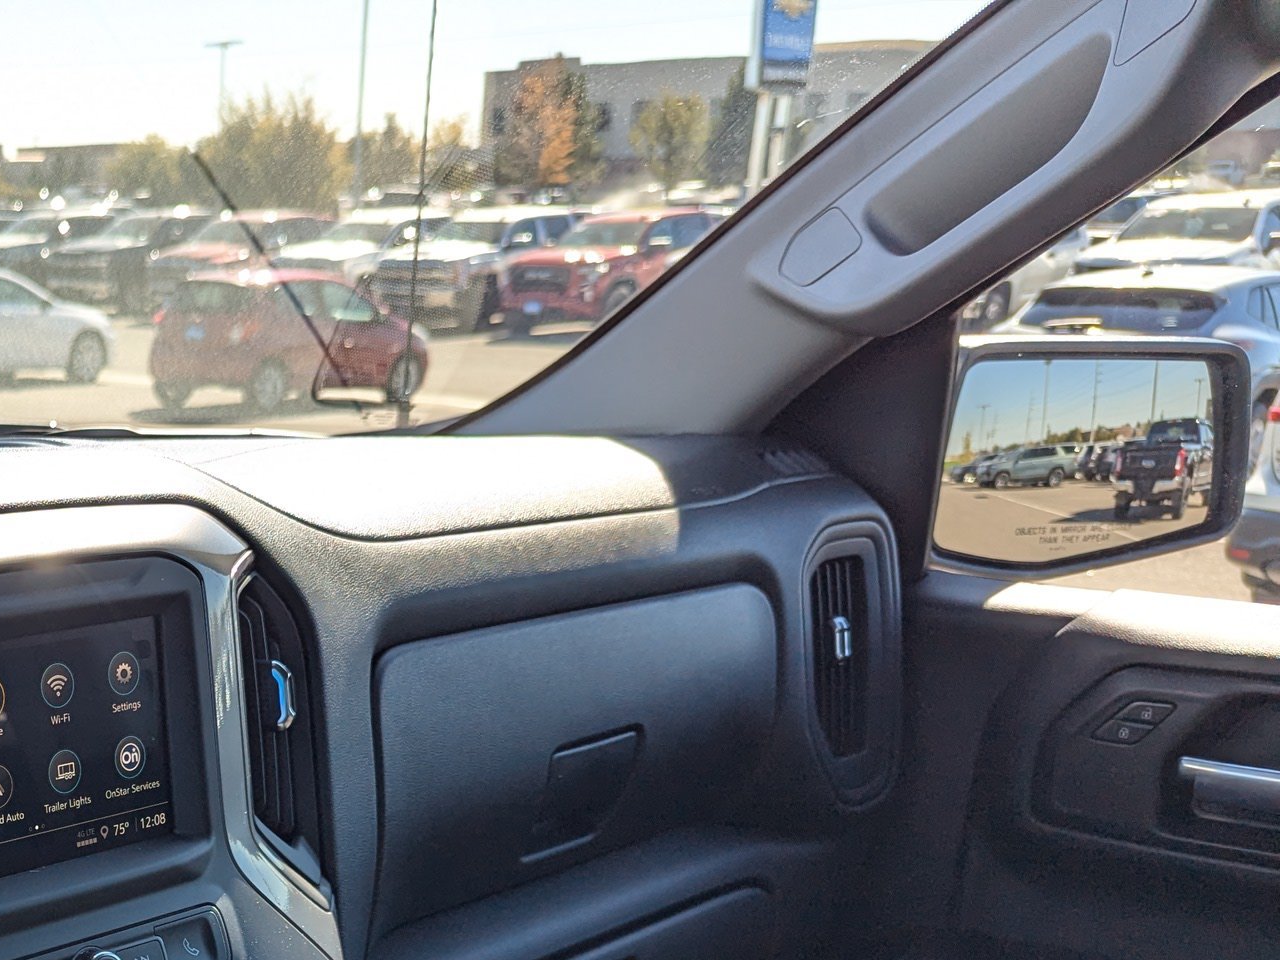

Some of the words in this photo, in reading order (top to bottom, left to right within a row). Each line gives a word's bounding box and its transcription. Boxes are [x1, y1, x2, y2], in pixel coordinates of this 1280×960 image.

[1015, 526, 1047, 536] OBJECTS
[1050, 526, 1057, 534] IN
[1061, 525, 1087, 533] MIRROR
[1039, 535, 1058, 544] THAN
[1062, 534, 1080, 543] THEY
[1083, 533, 1111, 543] APPEAR
[112, 699, 141, 714] Settings
[50, 713, 71, 725] Wi-Fi
[121, 747, 139, 765] On
[105, 787, 130, 801] OnStar
[131, 779, 161, 795] Services
[44, 802, 68, 814] Trailer
[69, 795, 92, 810] Lights
[6, 811, 25, 824] Auto
[140, 812, 167, 829] 12:08
